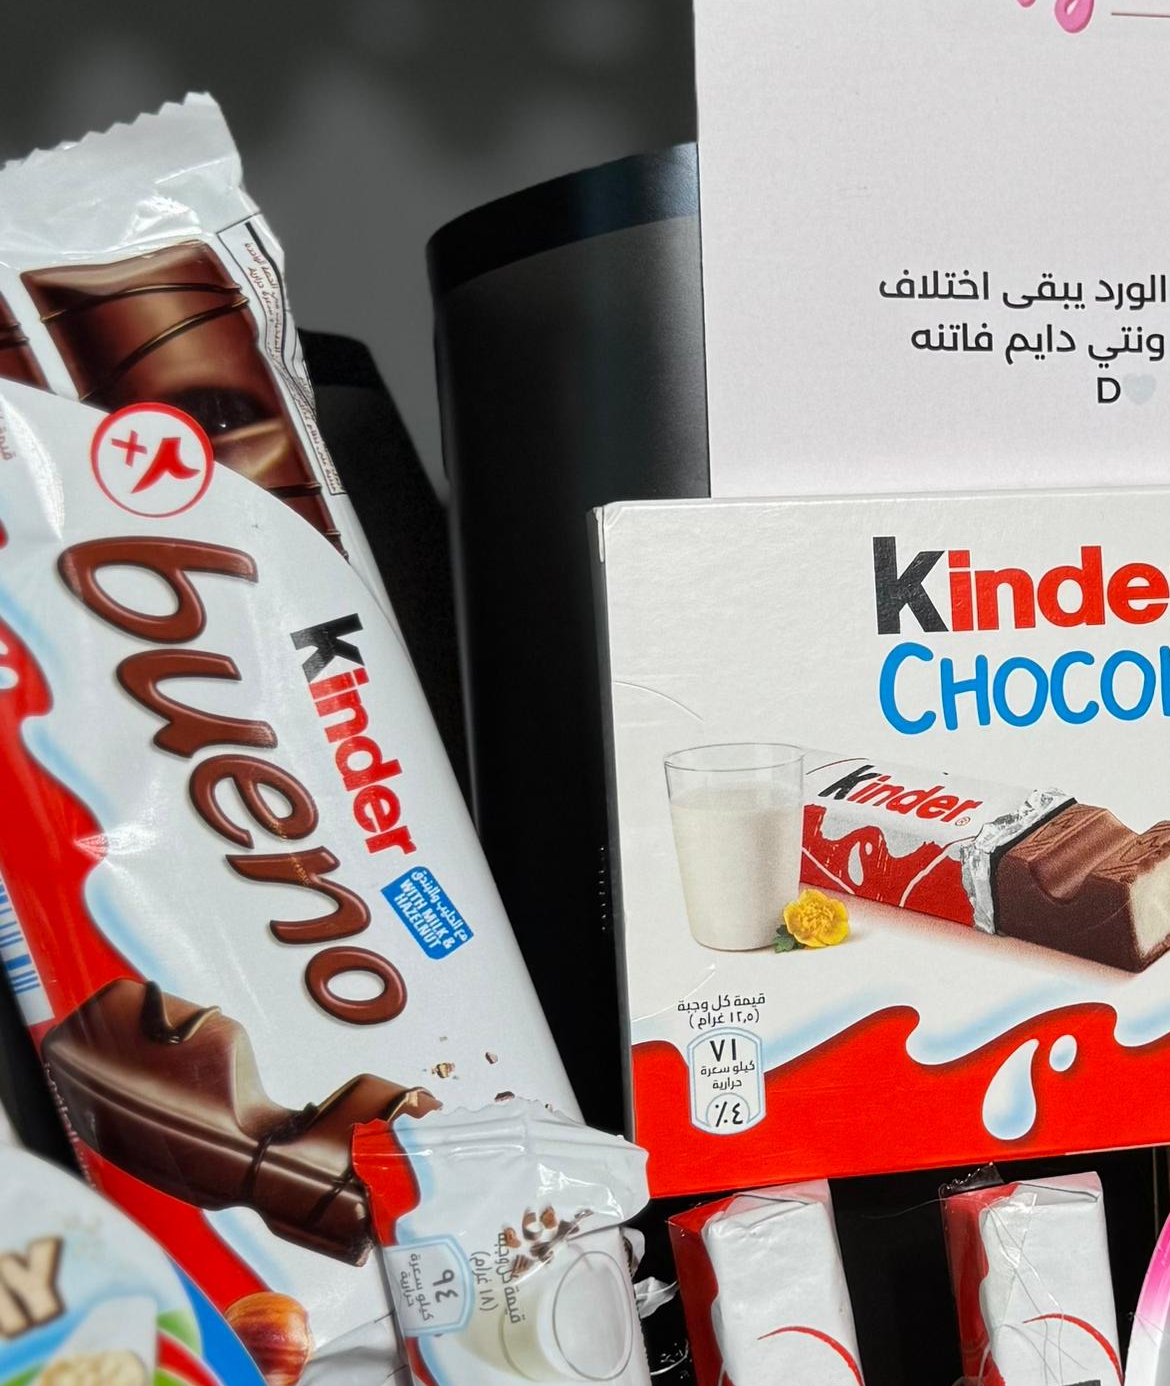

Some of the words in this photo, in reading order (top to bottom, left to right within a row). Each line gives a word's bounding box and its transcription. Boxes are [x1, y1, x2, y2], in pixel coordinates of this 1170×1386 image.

[878, 269, 990, 301] اختلاف
[1002, 272, 1085, 310] يبقى
[1094, 274, 1167, 310] الورد
[910, 322, 994, 352] فاتنه
[1005, 324, 1077, 365] دايم
[1087, 326, 1166, 369] ونتي
[1096, 377, 1122, 404] D
[289, 613, 417, 855] Kinder
[57, 535, 409, 1025] bueno
[818, 764, 984, 823] Kinder
[393, 892, 442, 949] HAZELNUT
[399, 878, 428, 910] WITH
[421, 907, 449, 939] MILK
[442, 936, 456, 950] &
[677, 999, 709, 1014] وجبة
[711, 994, 731, 1011] كل
[734, 993, 766, 1008] قيمة
[709, 1038, 737, 1062] ٧١
[700, 1065, 731, 1077] سعرة
[712, 1077, 743, 1091] حرارية
[732, 1060, 756, 1075] كيلو
[409, 1253, 423, 1291] سعرة
[415, 1294, 434, 1322] كيلو
[504, 1286, 526, 1324] قيمة
